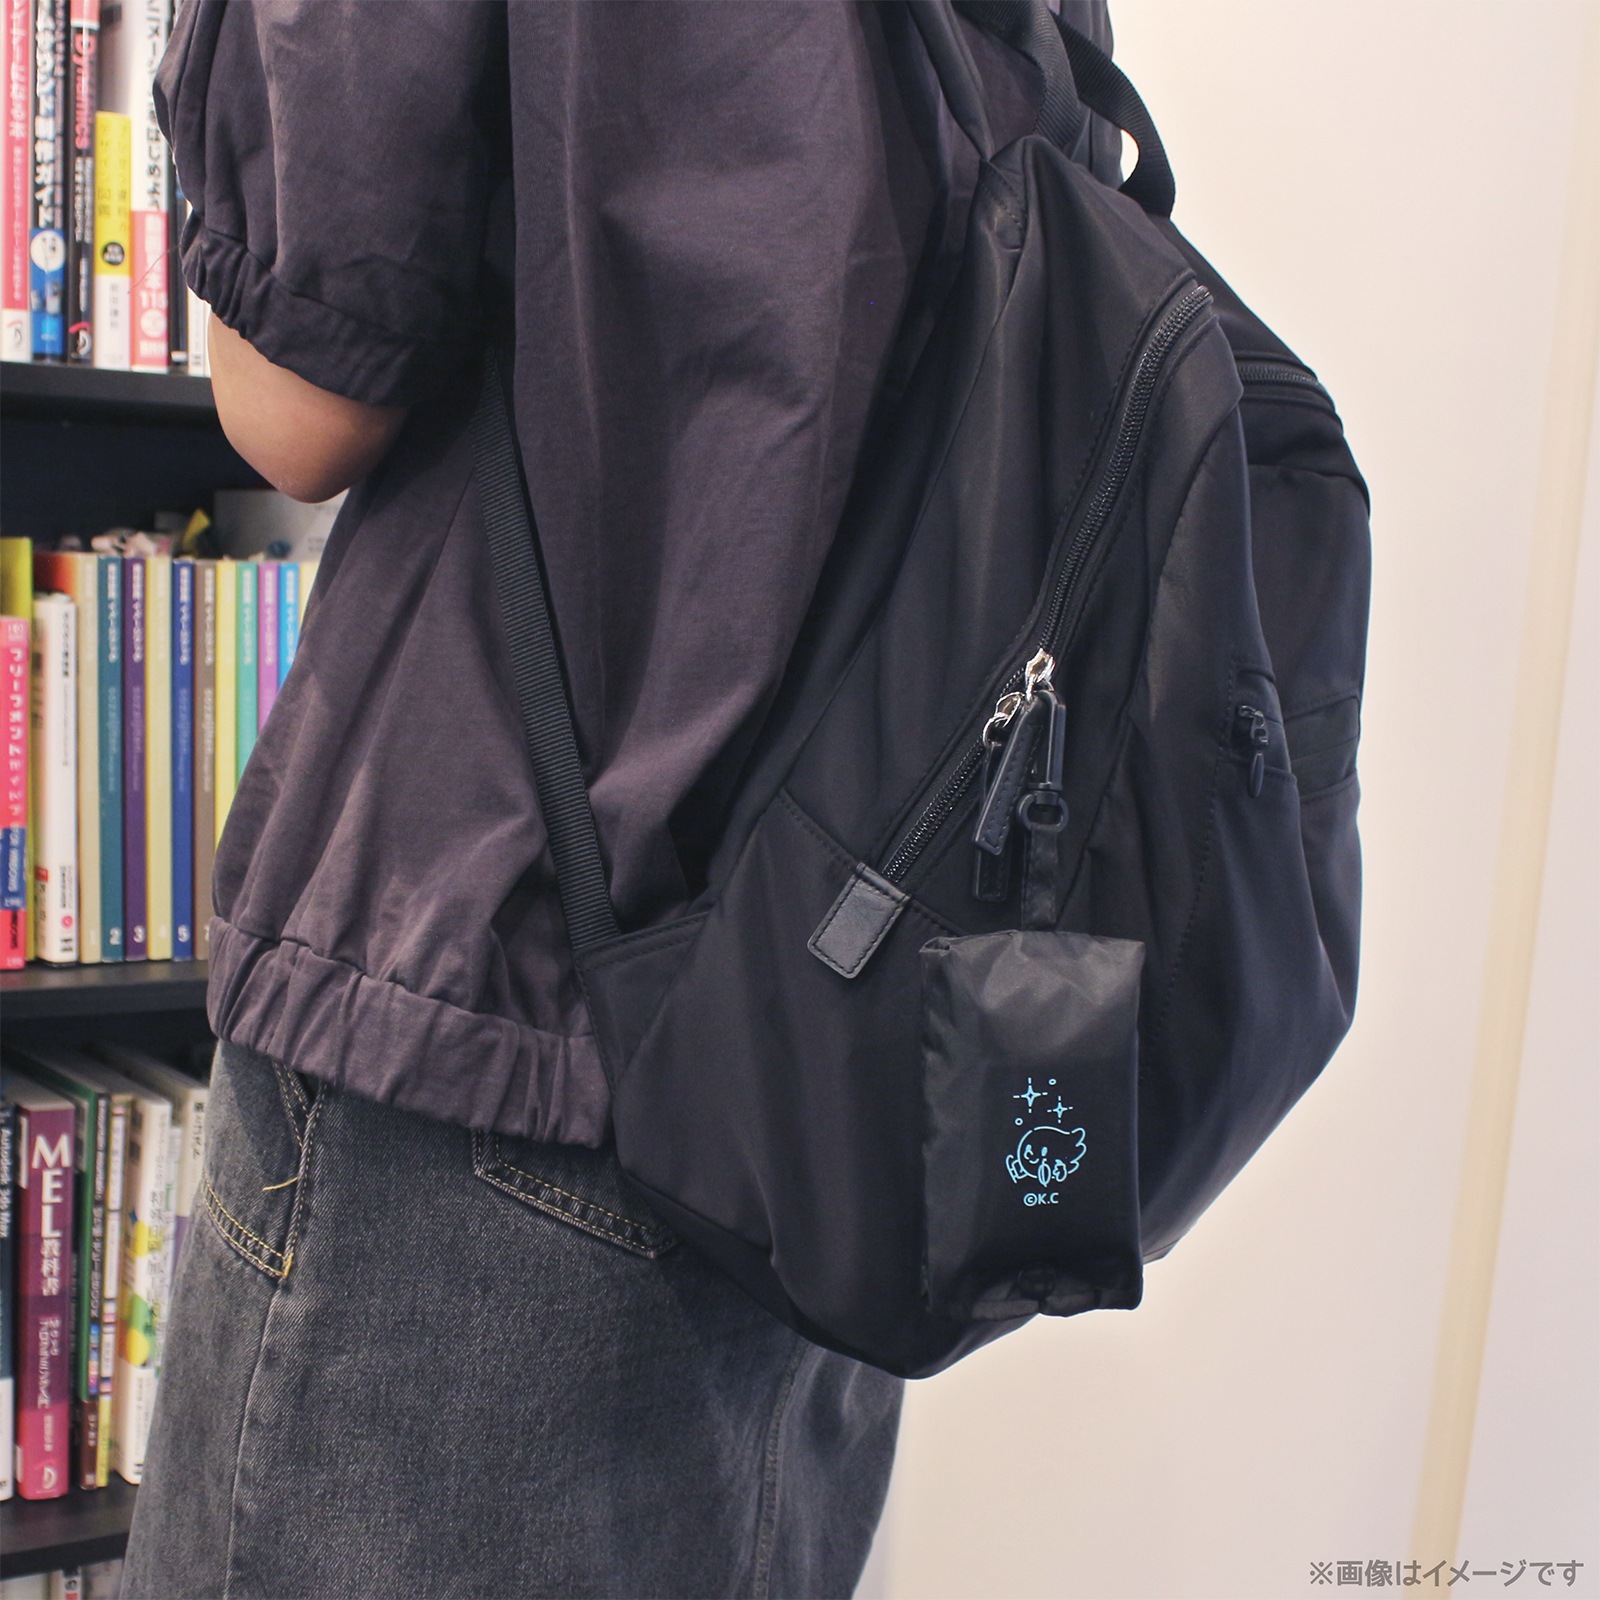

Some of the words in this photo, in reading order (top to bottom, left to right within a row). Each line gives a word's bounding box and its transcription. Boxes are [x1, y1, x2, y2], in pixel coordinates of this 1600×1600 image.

[72, 33, 96, 149] Dynamics
[109, 926, 122, 946] 2
[133, 925, 145, 943] 3
[177, 924, 190, 943] 5
[1, 1128, 12, 1185] Autodesk
